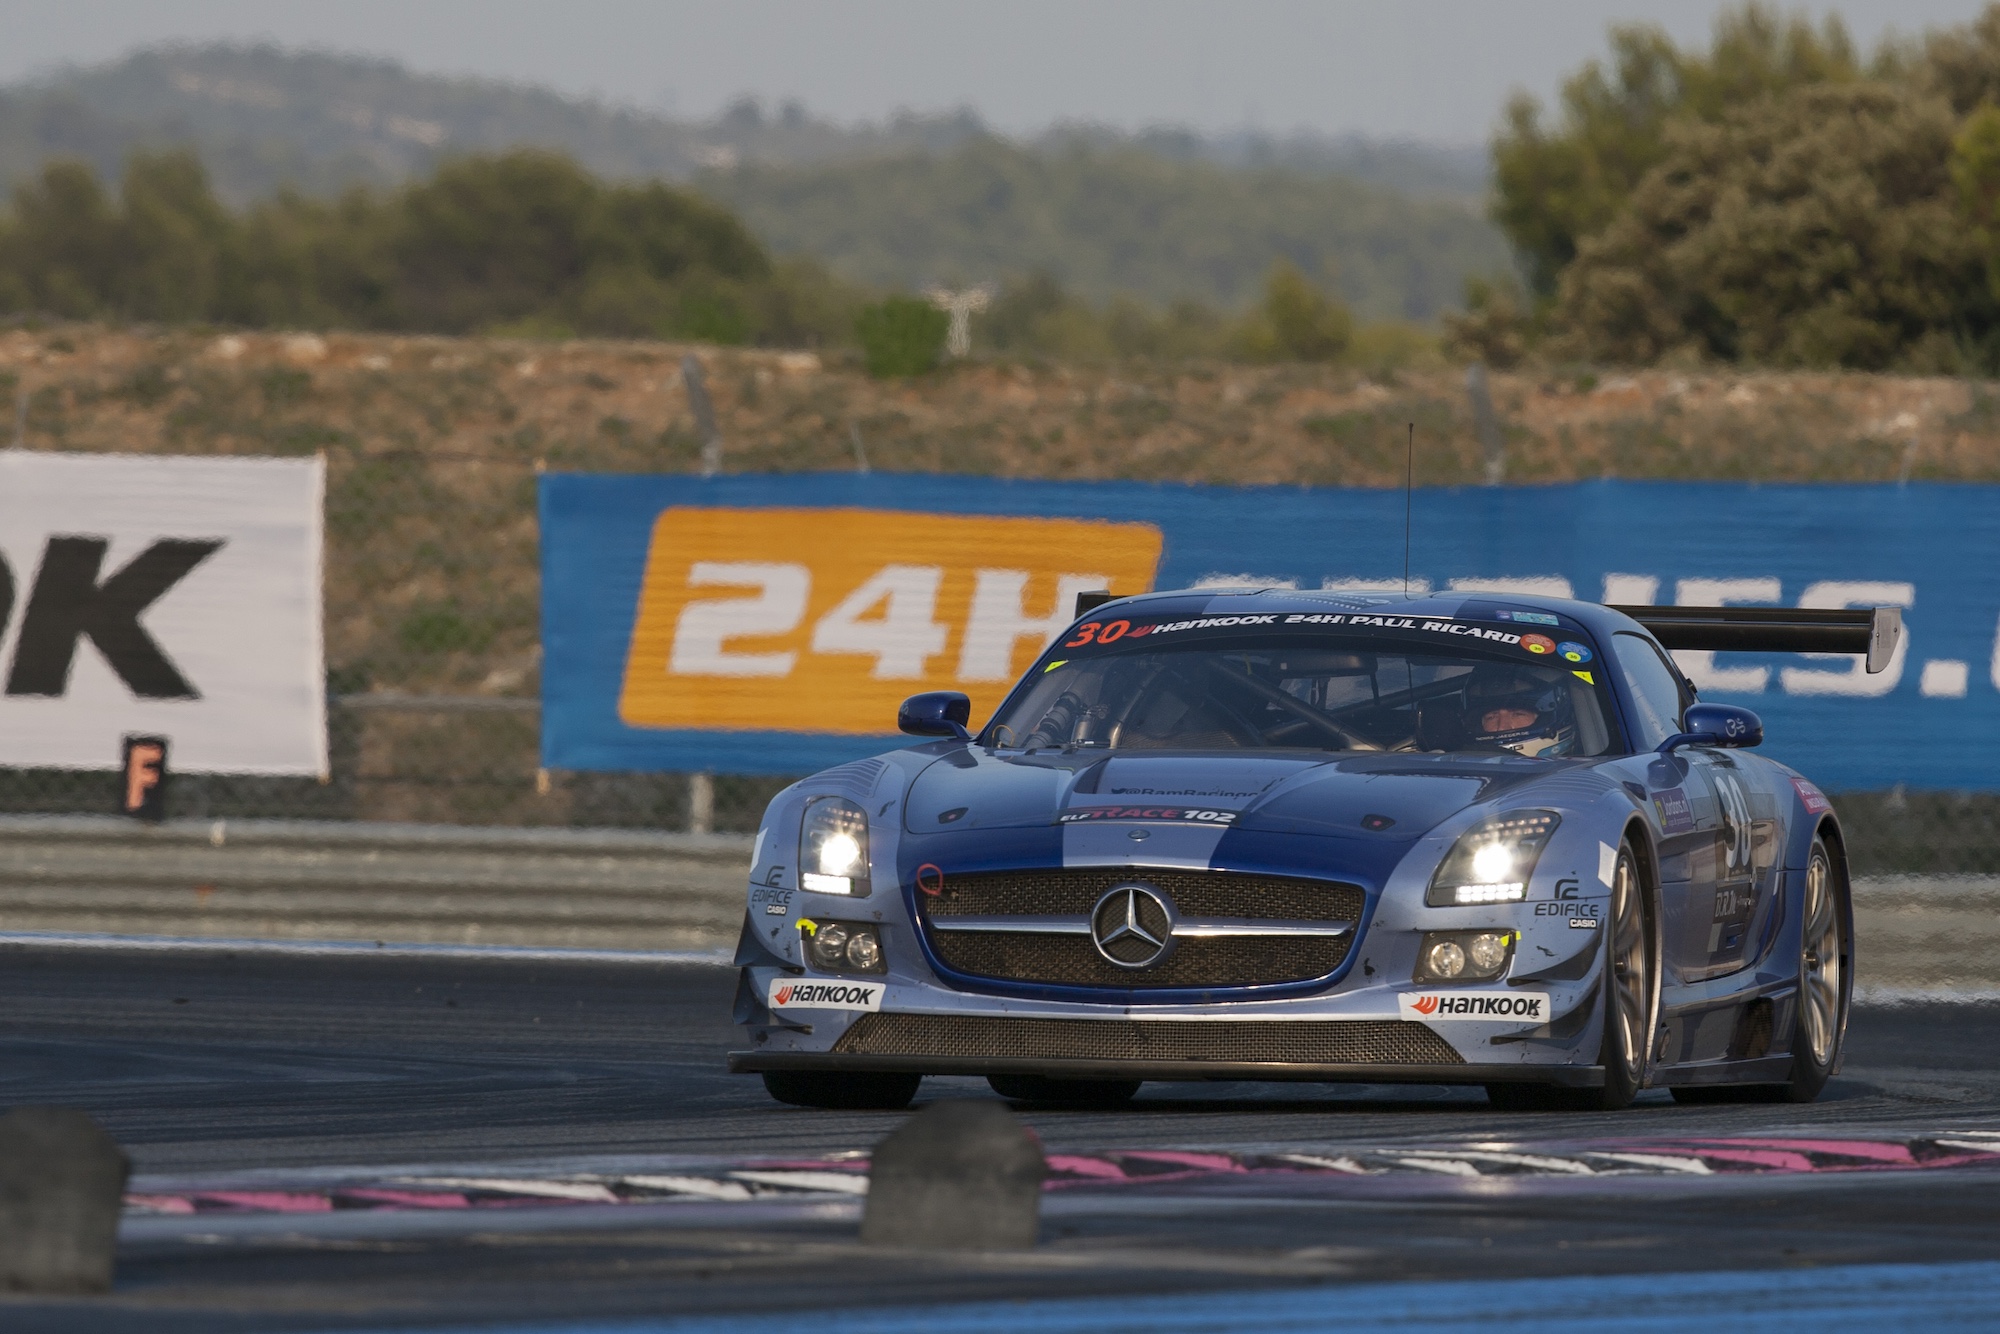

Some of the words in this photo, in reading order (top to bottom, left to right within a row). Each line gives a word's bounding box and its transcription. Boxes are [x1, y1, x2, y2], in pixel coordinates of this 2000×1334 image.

[0, 534, 228, 699] K
[668, 561, 1112, 684] 24H
[1065, 619, 1131, 648] 30
[1349, 615, 1416, 629] PAUL
[1421, 620, 1521, 645] RICARD
[126, 743, 165, 812] F
[1060, 813, 1091, 822] ELF
[1088, 806, 1180, 819] RACE
[1184, 809, 1237, 823] 102
[1716, 775, 1752, 868] 30
[751, 889, 793, 905] EDIFICE
[767, 906, 786, 915] CASIO
[1534, 903, 1599, 917] EDIFICE
[1570, 919, 1597, 928] CASIO
